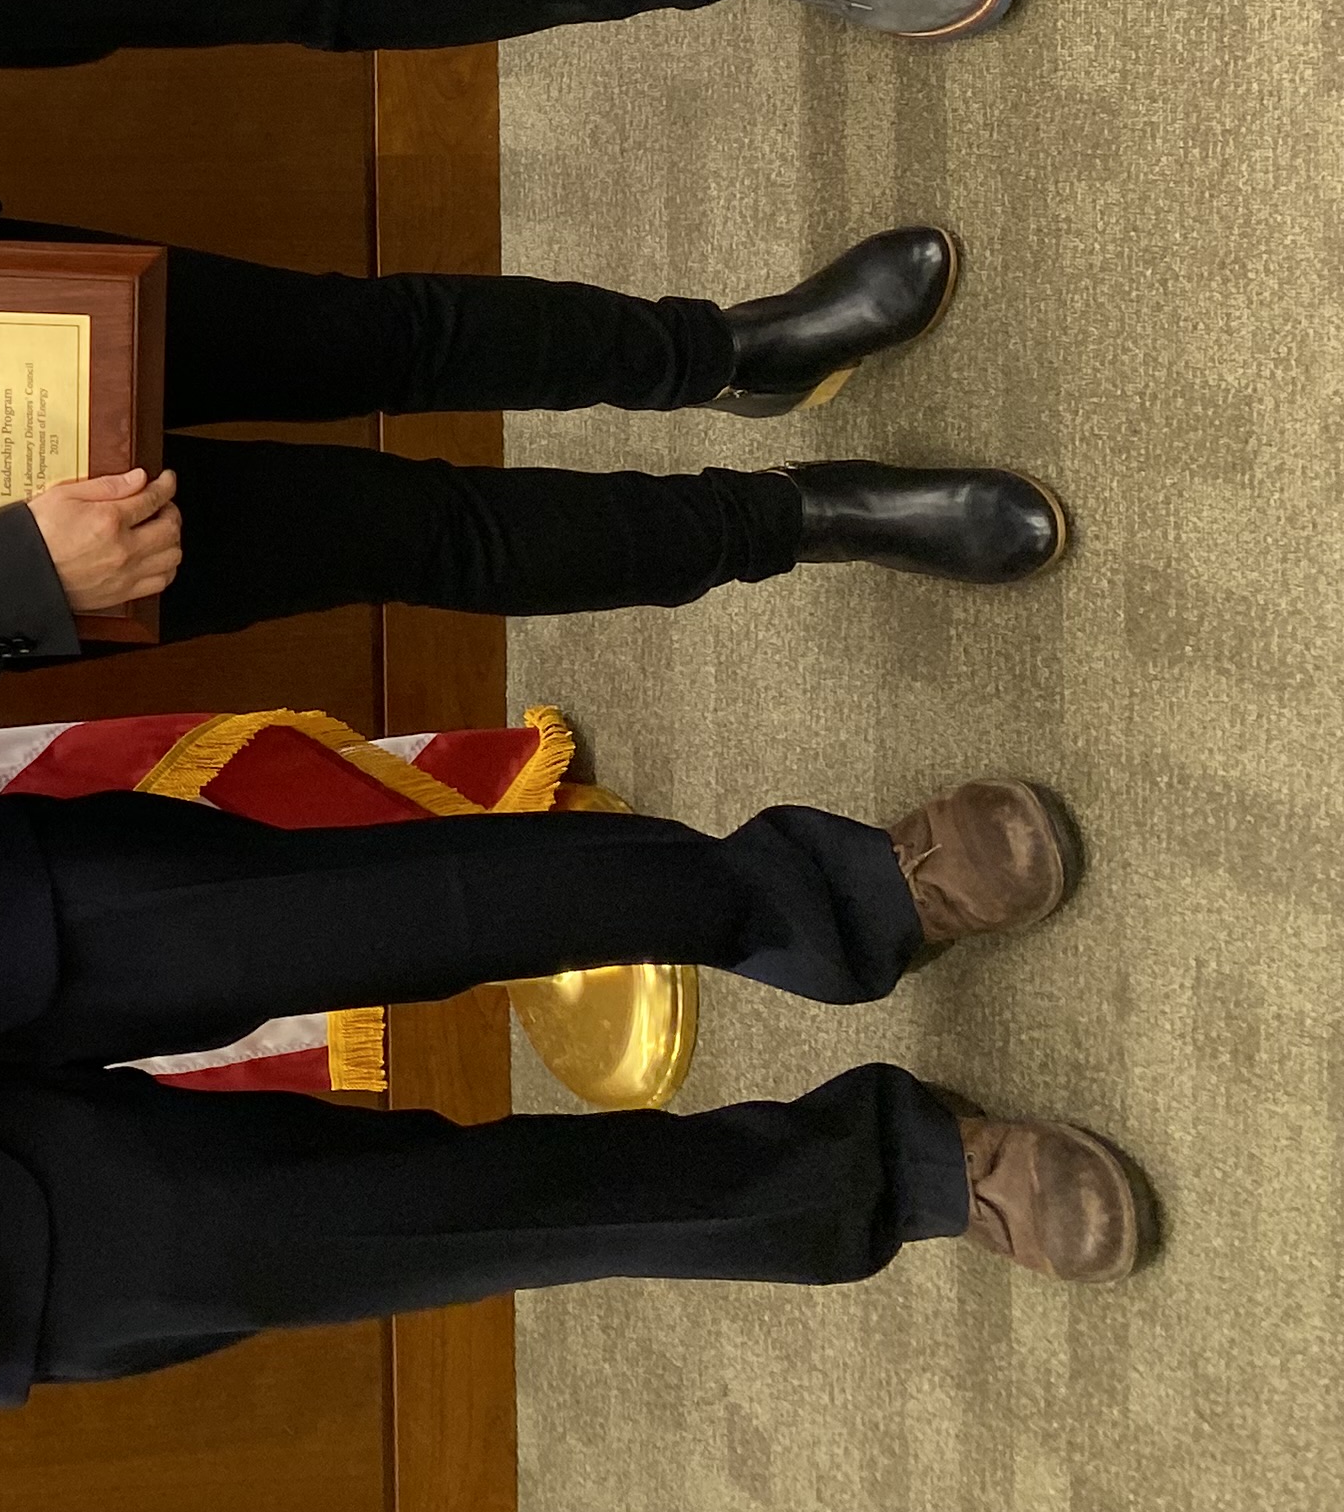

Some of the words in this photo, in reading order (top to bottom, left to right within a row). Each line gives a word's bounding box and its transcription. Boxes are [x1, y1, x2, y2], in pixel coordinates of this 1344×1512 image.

[25, 363, 34, 395] Council
[2, 389, 14, 434] Program
[24, 397, 33, 438] Directors'
[38, 388, 48, 417] Energy
[37, 419, 46, 428] of
[24, 441, 35, 486] Laboratory
[37, 431, 47, 480] Department
[50, 434, 59, 455] 2023
[1, 438, 14, 496] Leadership
